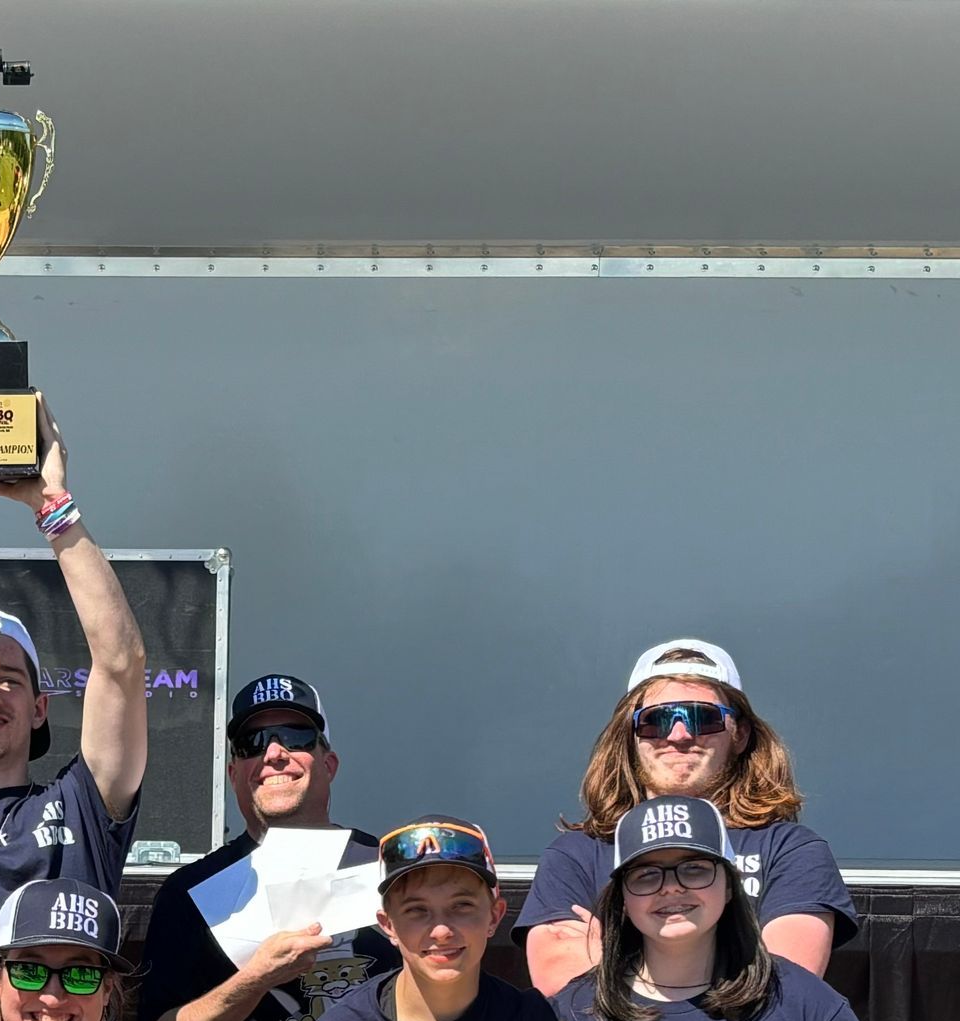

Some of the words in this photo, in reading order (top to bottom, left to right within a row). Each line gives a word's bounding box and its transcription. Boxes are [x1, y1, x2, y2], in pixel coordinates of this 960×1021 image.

[253, 678, 293, 695] AHS
[641, 804, 690, 827] AHS
[641, 821, 693, 844] BBQ
[735, 853, 761, 873] HS
[51, 892, 99, 919] AHS
[49, 911, 99, 939] BBQ
